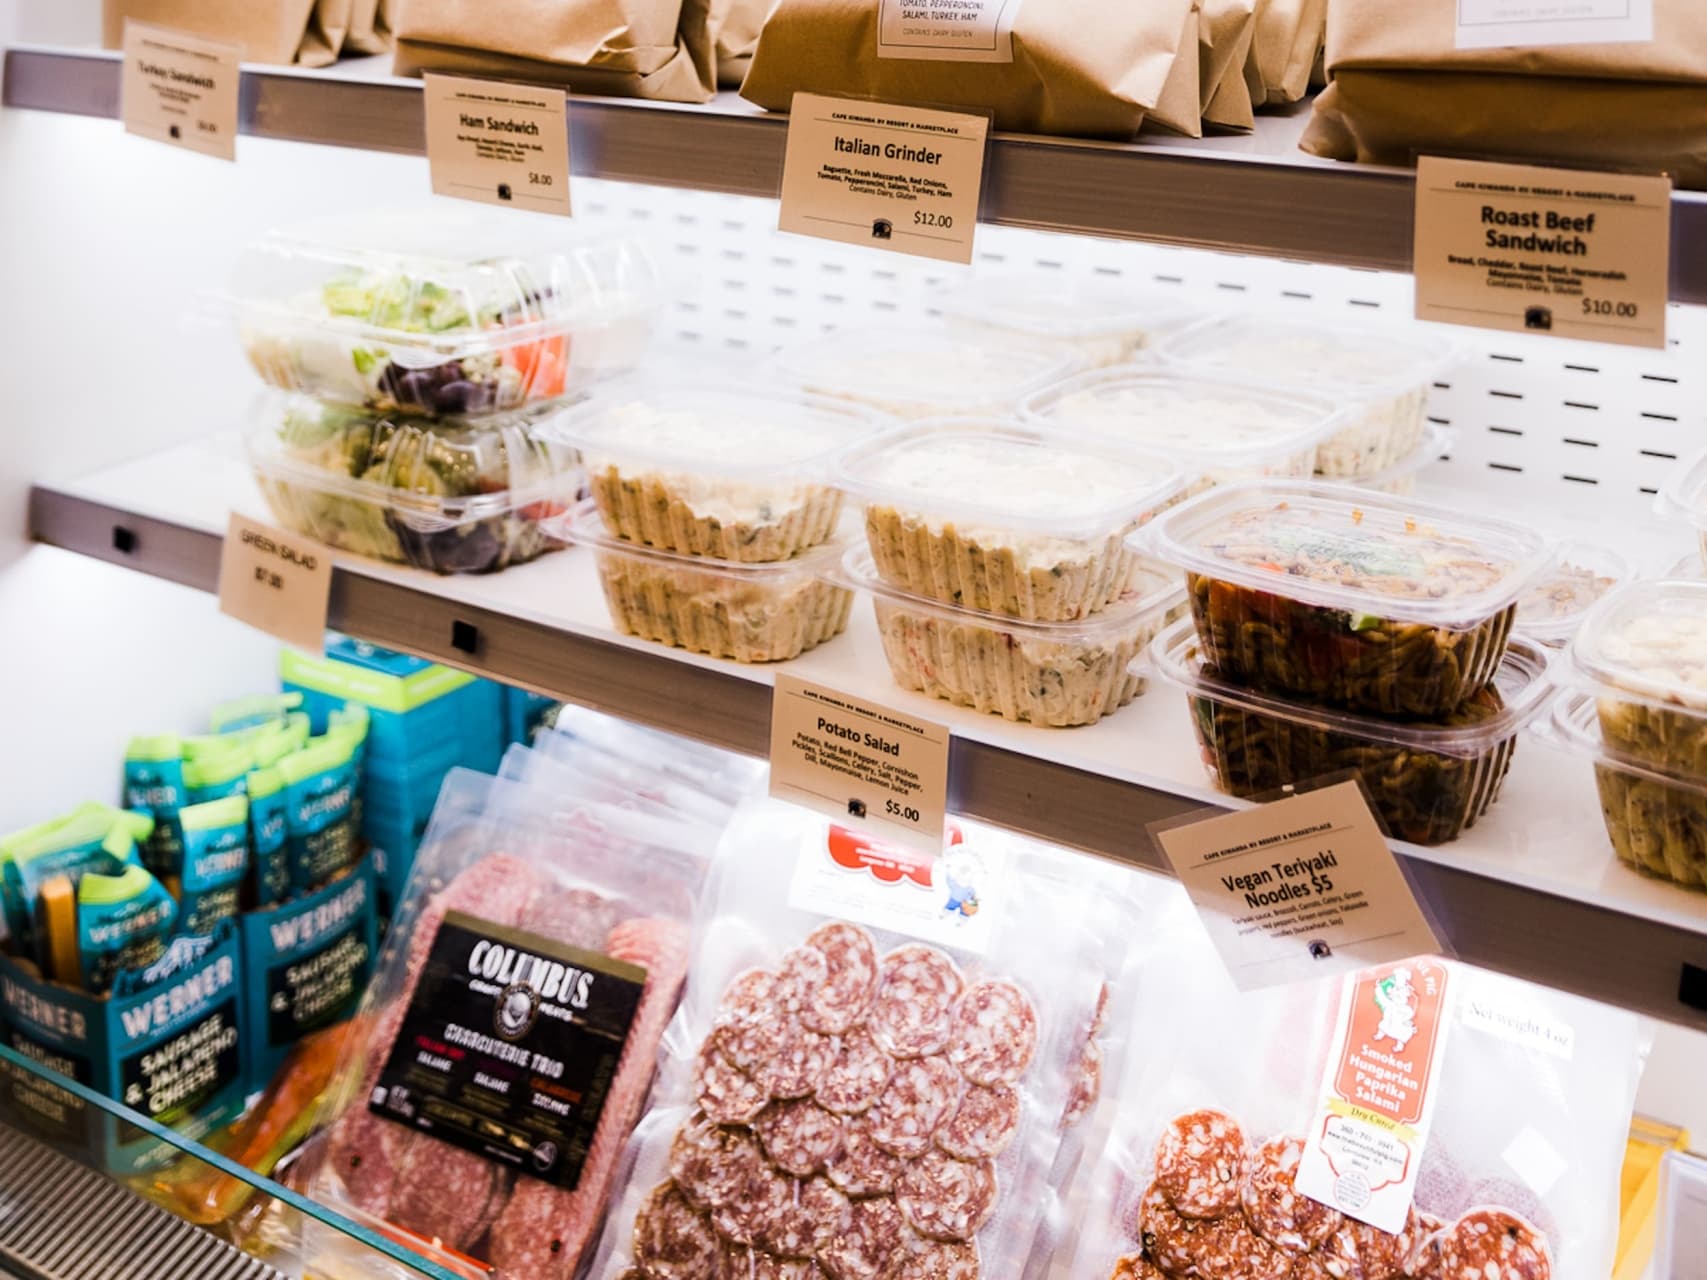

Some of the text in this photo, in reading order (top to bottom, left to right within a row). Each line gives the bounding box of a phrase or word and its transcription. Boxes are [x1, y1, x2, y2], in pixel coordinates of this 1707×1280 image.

[960, 12, 978, 21] HAM
[460, 113, 539, 136] Ham Sandwich
[832, 112, 958, 134] CAPE RESORT MARKETPLACE
[834, 136, 942, 165] Italian Grinder
[529, 172, 552, 185] $8.00
[818, 172, 952, 198] Tomato, Pepperoncini, Salami, Turkey, Ham
[823, 164, 948, 189] Baguette, Fresh Mozzarella, Red Onions,
[1455, 181, 1476, 189] CAPE
[849, 184, 917, 200] Contains Dairy, Gluten
[914, 210, 953, 229] $12.00
[1481, 205, 1596, 233] Roast Beef
[1486, 229, 1587, 256] Sandwich
[1487, 278, 1523, 289] Contains
[1582, 298, 1637, 318] $10.00
[803, 690, 924, 734] CAPE MARKETPLACE
[797, 732, 881, 768] Potato, Red Bell Pepper,
[818, 717, 900, 757] Potato Salad
[791, 740, 923, 792] Pickles, Scallions, Celery, Salt, Pepper,
[805, 753, 909, 795] Dill, Lemon Juice
[885, 799, 920, 822] $5.00
[1203, 822, 1332, 861] CAPE KIWANDA RESORT MARKETPLACE
[1221, 850, 1338, 892] Vegan Teriyaki
[1244, 874, 1333, 909] Noodles $5
[1344, 890, 1363, 900] Green
[269, 878, 368, 952] WERNER
[1298, 912, 1316, 921] Green
[468, 940, 594, 1009] COLUMBUS
[1423, 975, 1438, 996] PIG
[3, 977, 87, 1041] WERNER
[121, 955, 233, 1039] WERNER
[1468, 1002, 1569, 1047] Net weight 4 oz
[140, 1012, 225, 1076] SAUSAGE
[444, 1023, 565, 1079] CHARCUTERIE TRIO
[1350, 1054, 1418, 1091] Hungarian
[1361, 1044, 1413, 1073] Smoked
[125, 1083, 143, 1105] &
[149, 1058, 218, 1113] CHEESE
[1355, 1071, 1406, 1100] Paprika
[1355, 1086, 1400, 1113] Salami
[1351, 1107, 1396, 1130] Dry Cured
